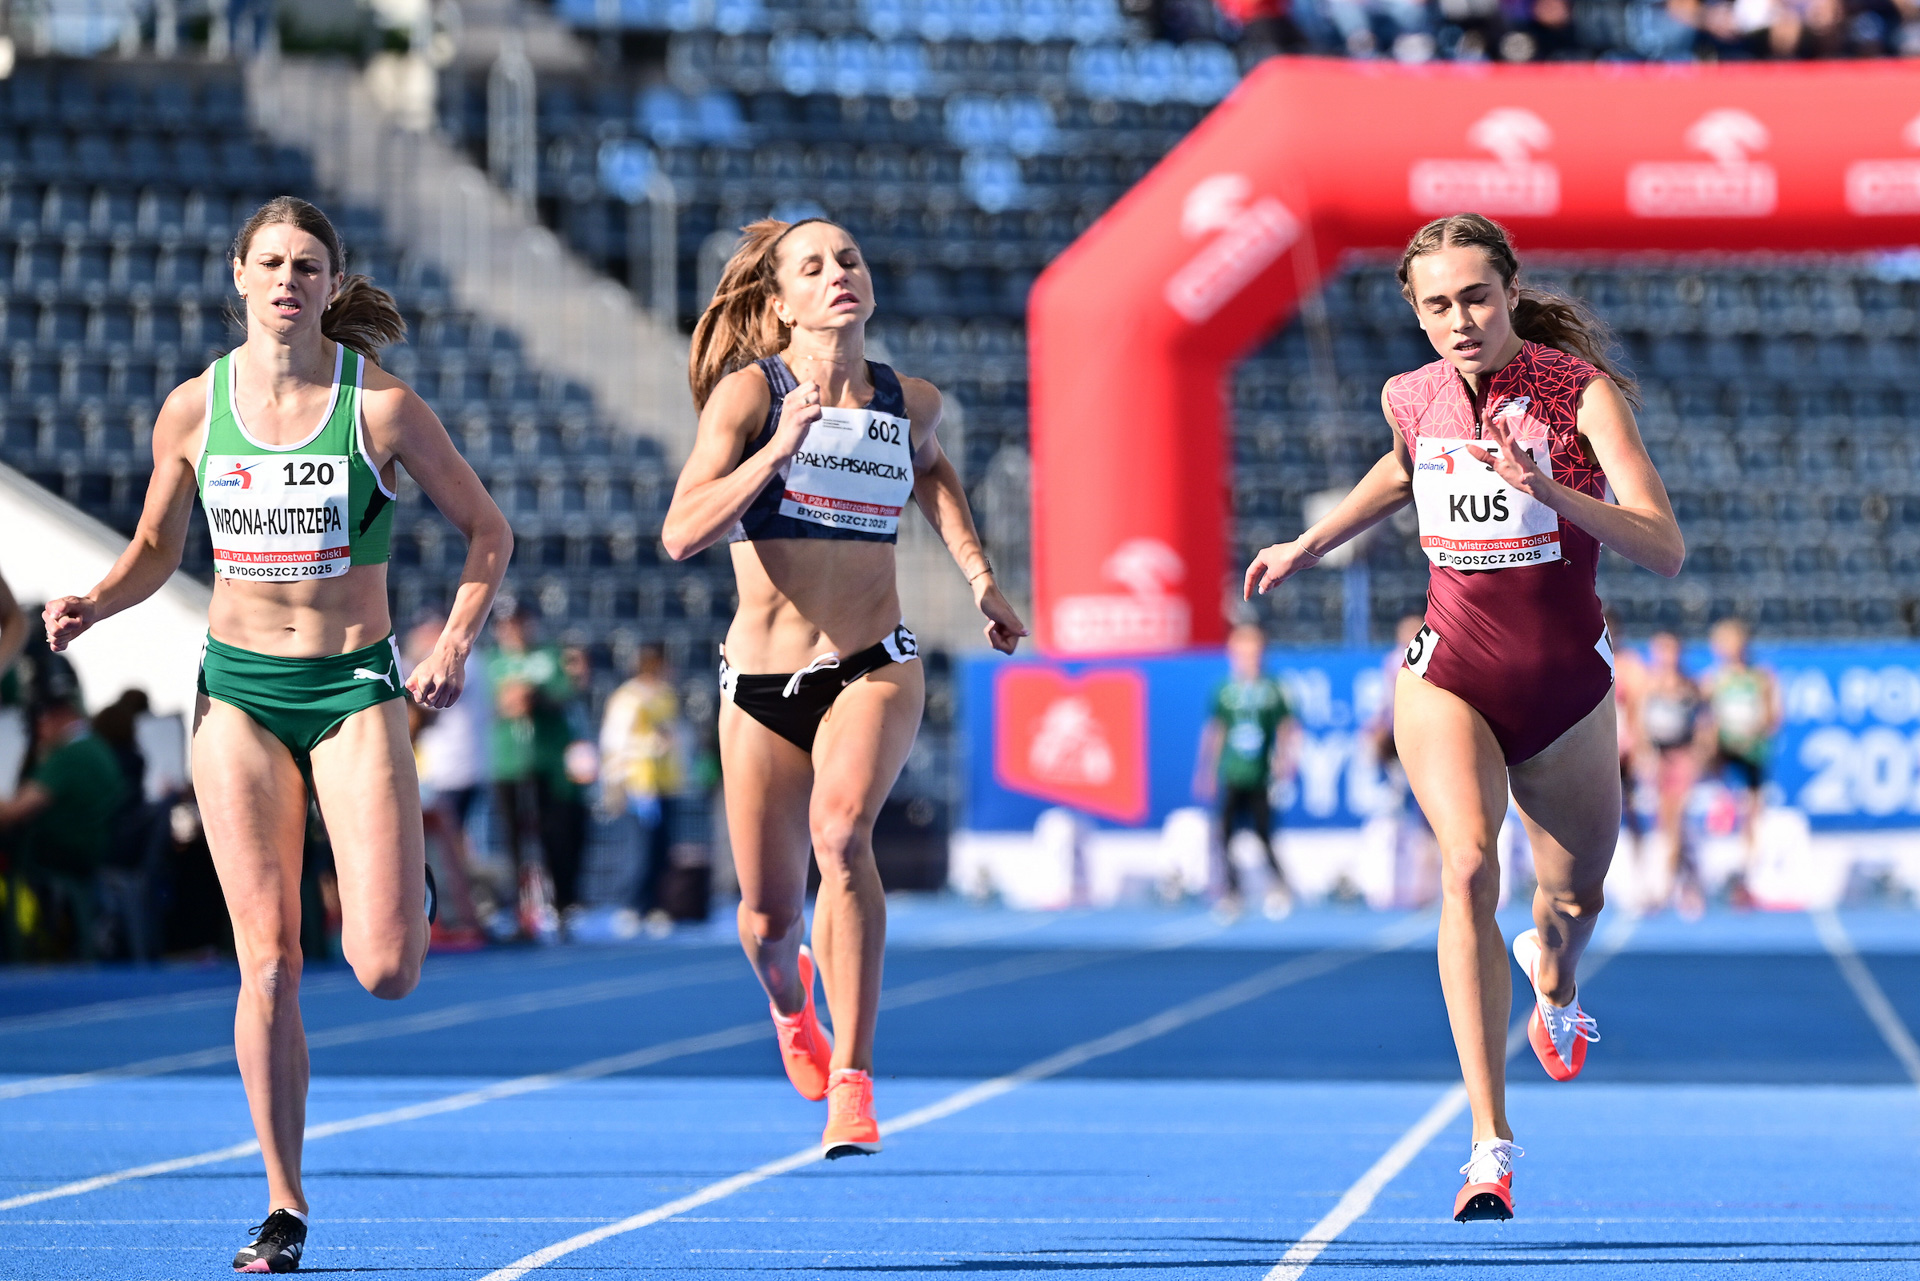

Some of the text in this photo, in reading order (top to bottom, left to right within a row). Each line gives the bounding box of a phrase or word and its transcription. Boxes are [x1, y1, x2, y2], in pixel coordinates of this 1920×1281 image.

[868, 418, 901, 446] 602
[282, 461, 335, 486] 120
[795, 450, 909, 482] PAŁYS-PISARCZUK
[1417, 462, 1446, 471] polanik
[208, 478, 241, 488] polanik
[808, 495, 830, 507] PZLA
[1449, 488, 1510, 523] KUŚ
[210, 505, 342, 535] WRONA-KUTRZEPA
[796, 506, 868, 527] BYDGOSZCZ
[1441, 540, 1457, 550] PZLA
[1458, 540, 1519, 551] Mistrzostwa
[1521, 533, 1551, 548] Polski
[219, 548, 342, 562] 101. PZLA Mistrzostwa Polski
[1509, 550, 1542, 563] 2025
[229, 564, 332, 577] BYDGOSZCZ 2025
[894, 624, 917, 656] 6
[1407, 622, 1432, 666] 5
